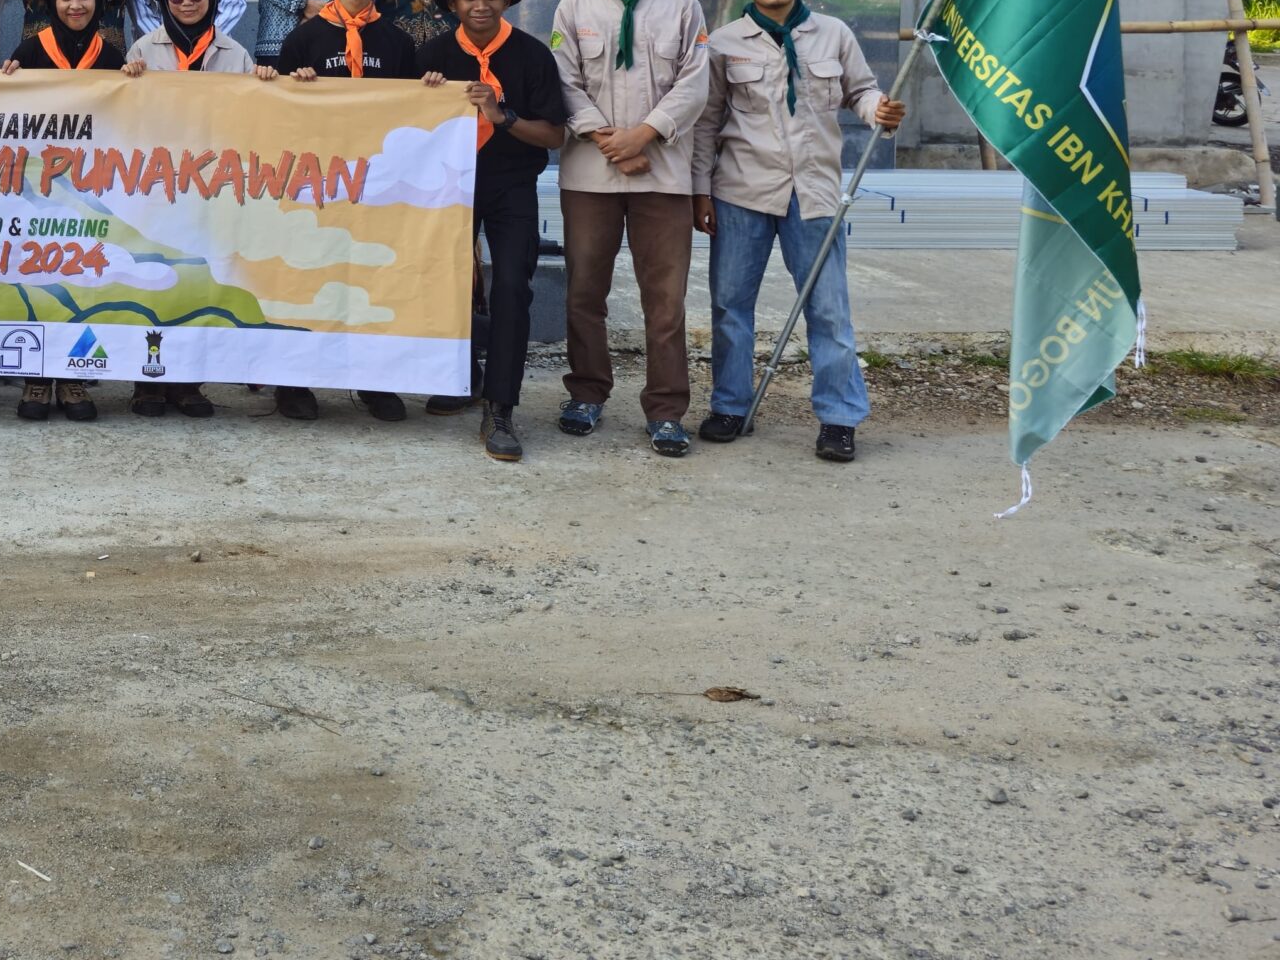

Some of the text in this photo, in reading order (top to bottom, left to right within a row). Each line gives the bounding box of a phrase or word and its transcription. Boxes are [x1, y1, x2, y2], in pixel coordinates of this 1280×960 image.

[1047, 125, 1104, 185] IBN
[40, 145, 370, 209] PUNAKAWAN
[8, 218, 21, 236] &
[27, 218, 109, 238] SUMBING
[18, 241, 111, 278] 2024
[67, 358, 107, 369] AOPGI
